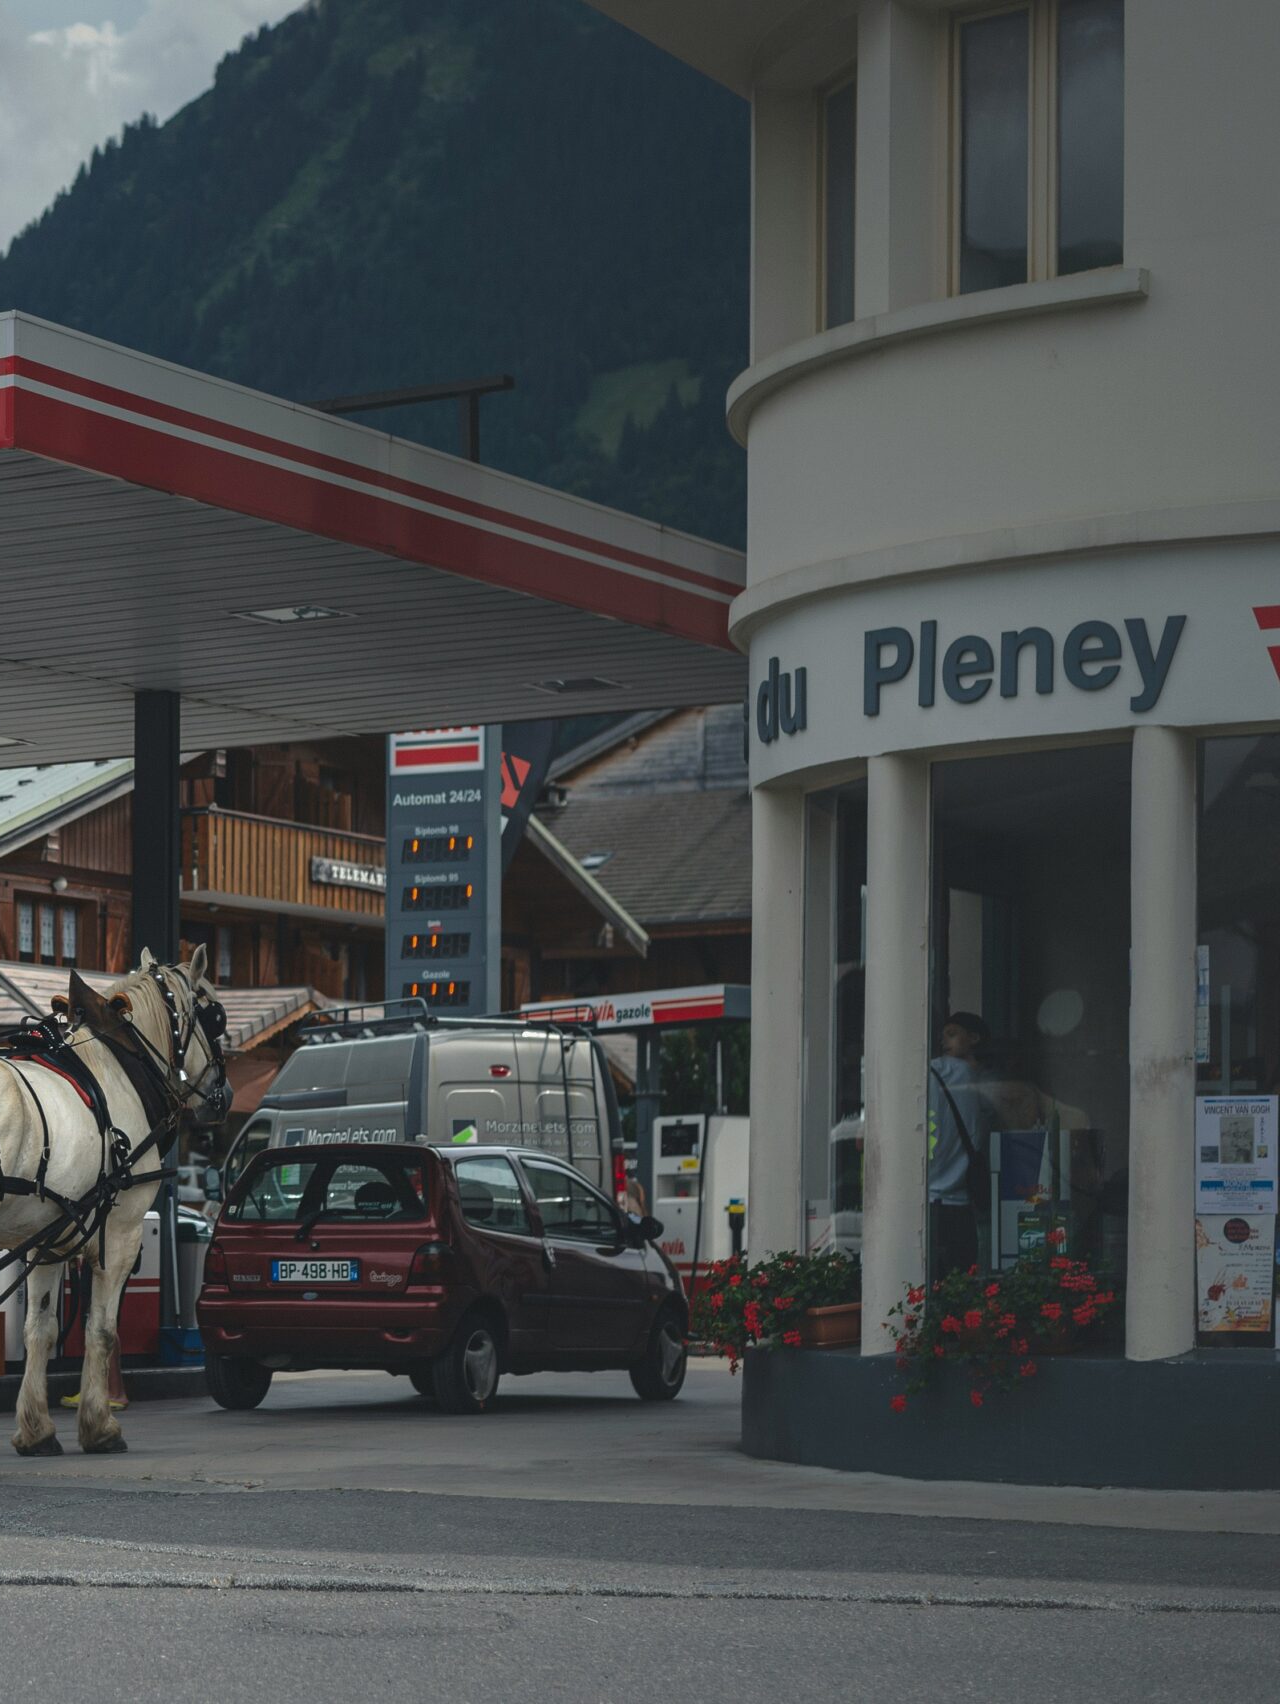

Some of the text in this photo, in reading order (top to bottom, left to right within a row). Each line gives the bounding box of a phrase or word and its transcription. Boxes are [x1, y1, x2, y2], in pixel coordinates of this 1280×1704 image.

[757, 614, 1188, 744] du Pleney
[393, 789, 482, 807] Automat 24/24
[332, 865, 387, 887] TELEMAR
[616, 1004, 651, 1023] gazole
[1204, 1104, 1271, 1115] VINCENT VAN GOGH
